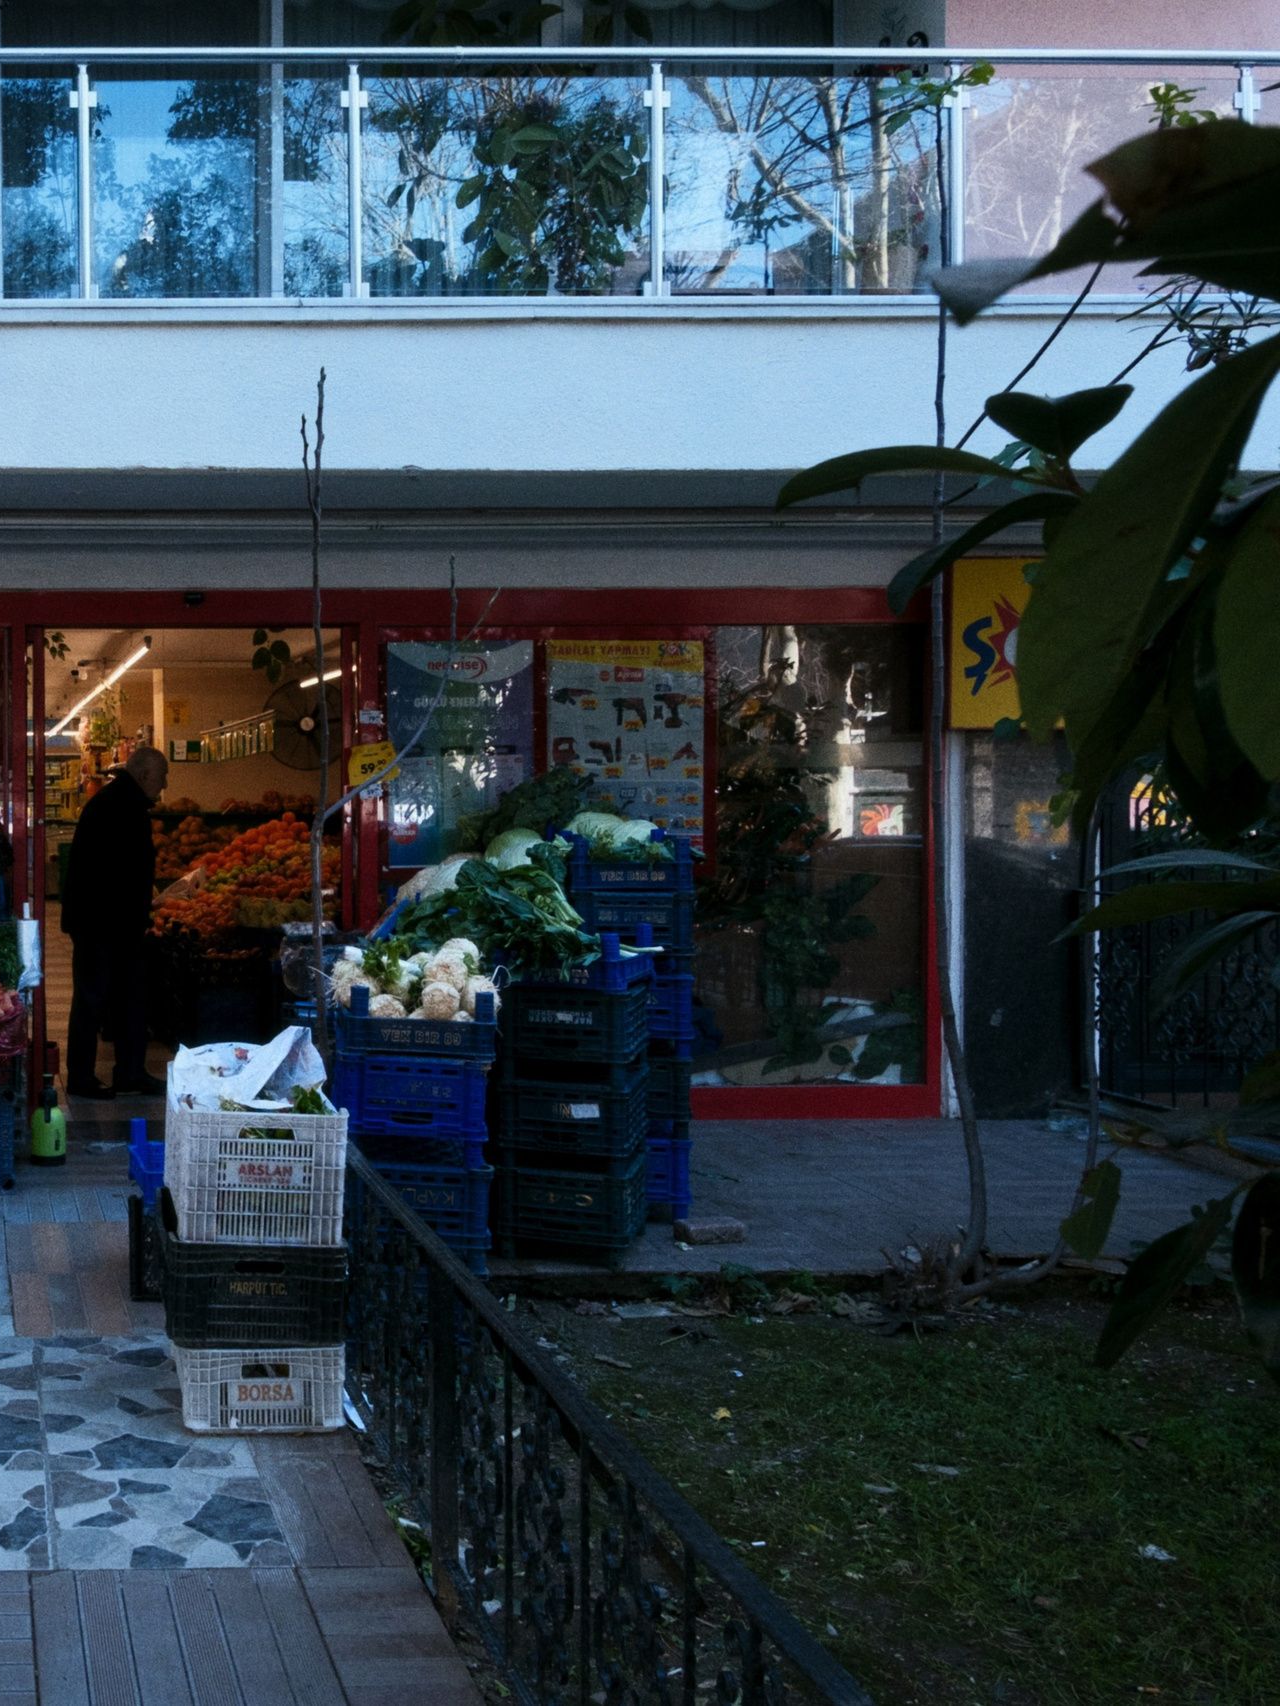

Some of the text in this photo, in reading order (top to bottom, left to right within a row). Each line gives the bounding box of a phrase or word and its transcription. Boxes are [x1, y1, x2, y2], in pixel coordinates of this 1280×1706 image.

[381, 1028, 411, 1043] YEK
[443, 1032, 462, 1046] 89
[238, 1163, 293, 1177] ARSLAN
[237, 1384, 294, 1402] BORSA
